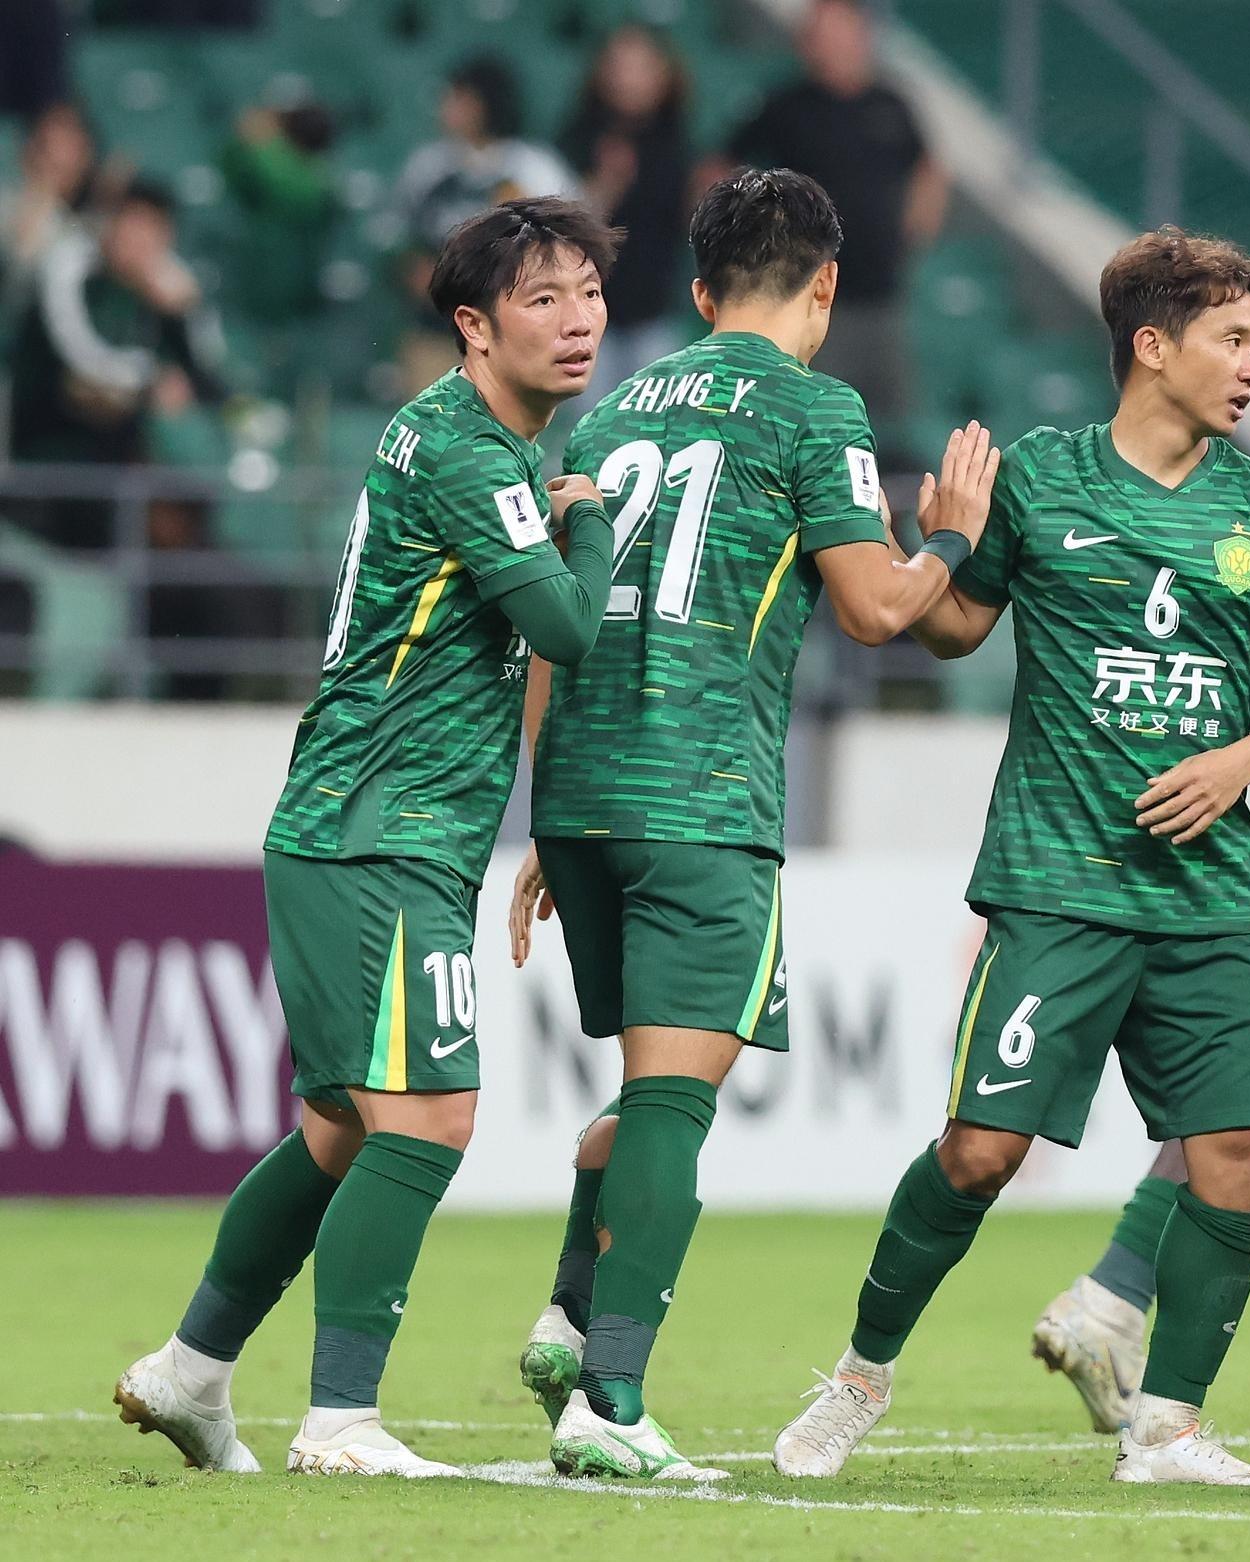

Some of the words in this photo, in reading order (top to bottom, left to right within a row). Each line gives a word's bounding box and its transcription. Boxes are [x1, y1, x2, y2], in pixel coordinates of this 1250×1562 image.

[617, 372, 714, 413] ZHANG
[729, 378, 757, 418] Y.
[596, 439, 725, 625] 21
[1144, 566, 1181, 639] 6
[1091, 646, 1228, 711] 京东
[1090, 707, 1221, 738] 又好又便宜
[423, 951, 476, 1029] 10
[998, 993, 1042, 1068] 6
